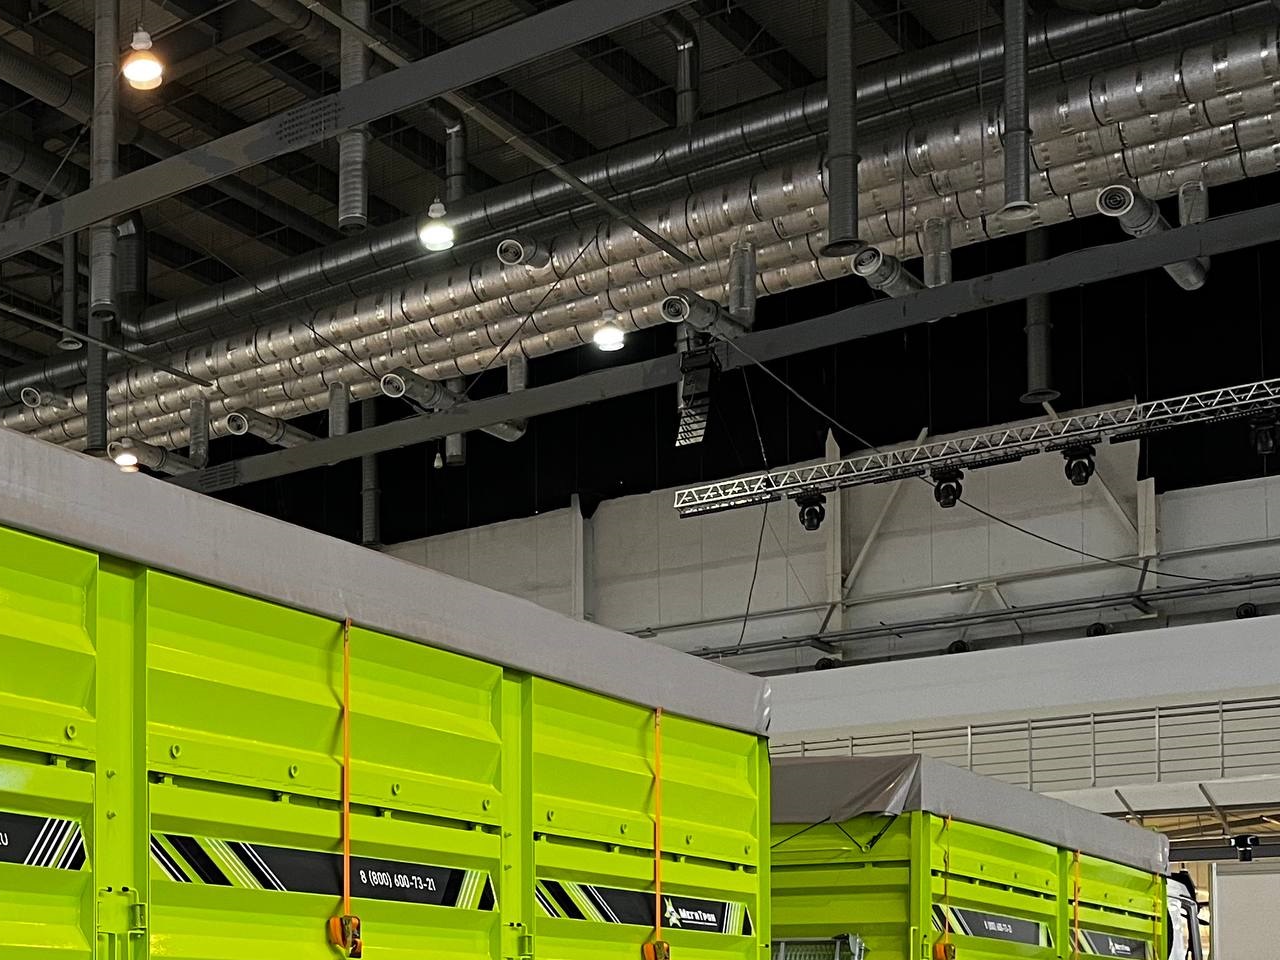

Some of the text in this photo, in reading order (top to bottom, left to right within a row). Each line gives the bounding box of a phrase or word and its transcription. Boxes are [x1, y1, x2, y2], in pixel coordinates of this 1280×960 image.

[360, 870, 436, 891] 8 (800) 600-73-21
